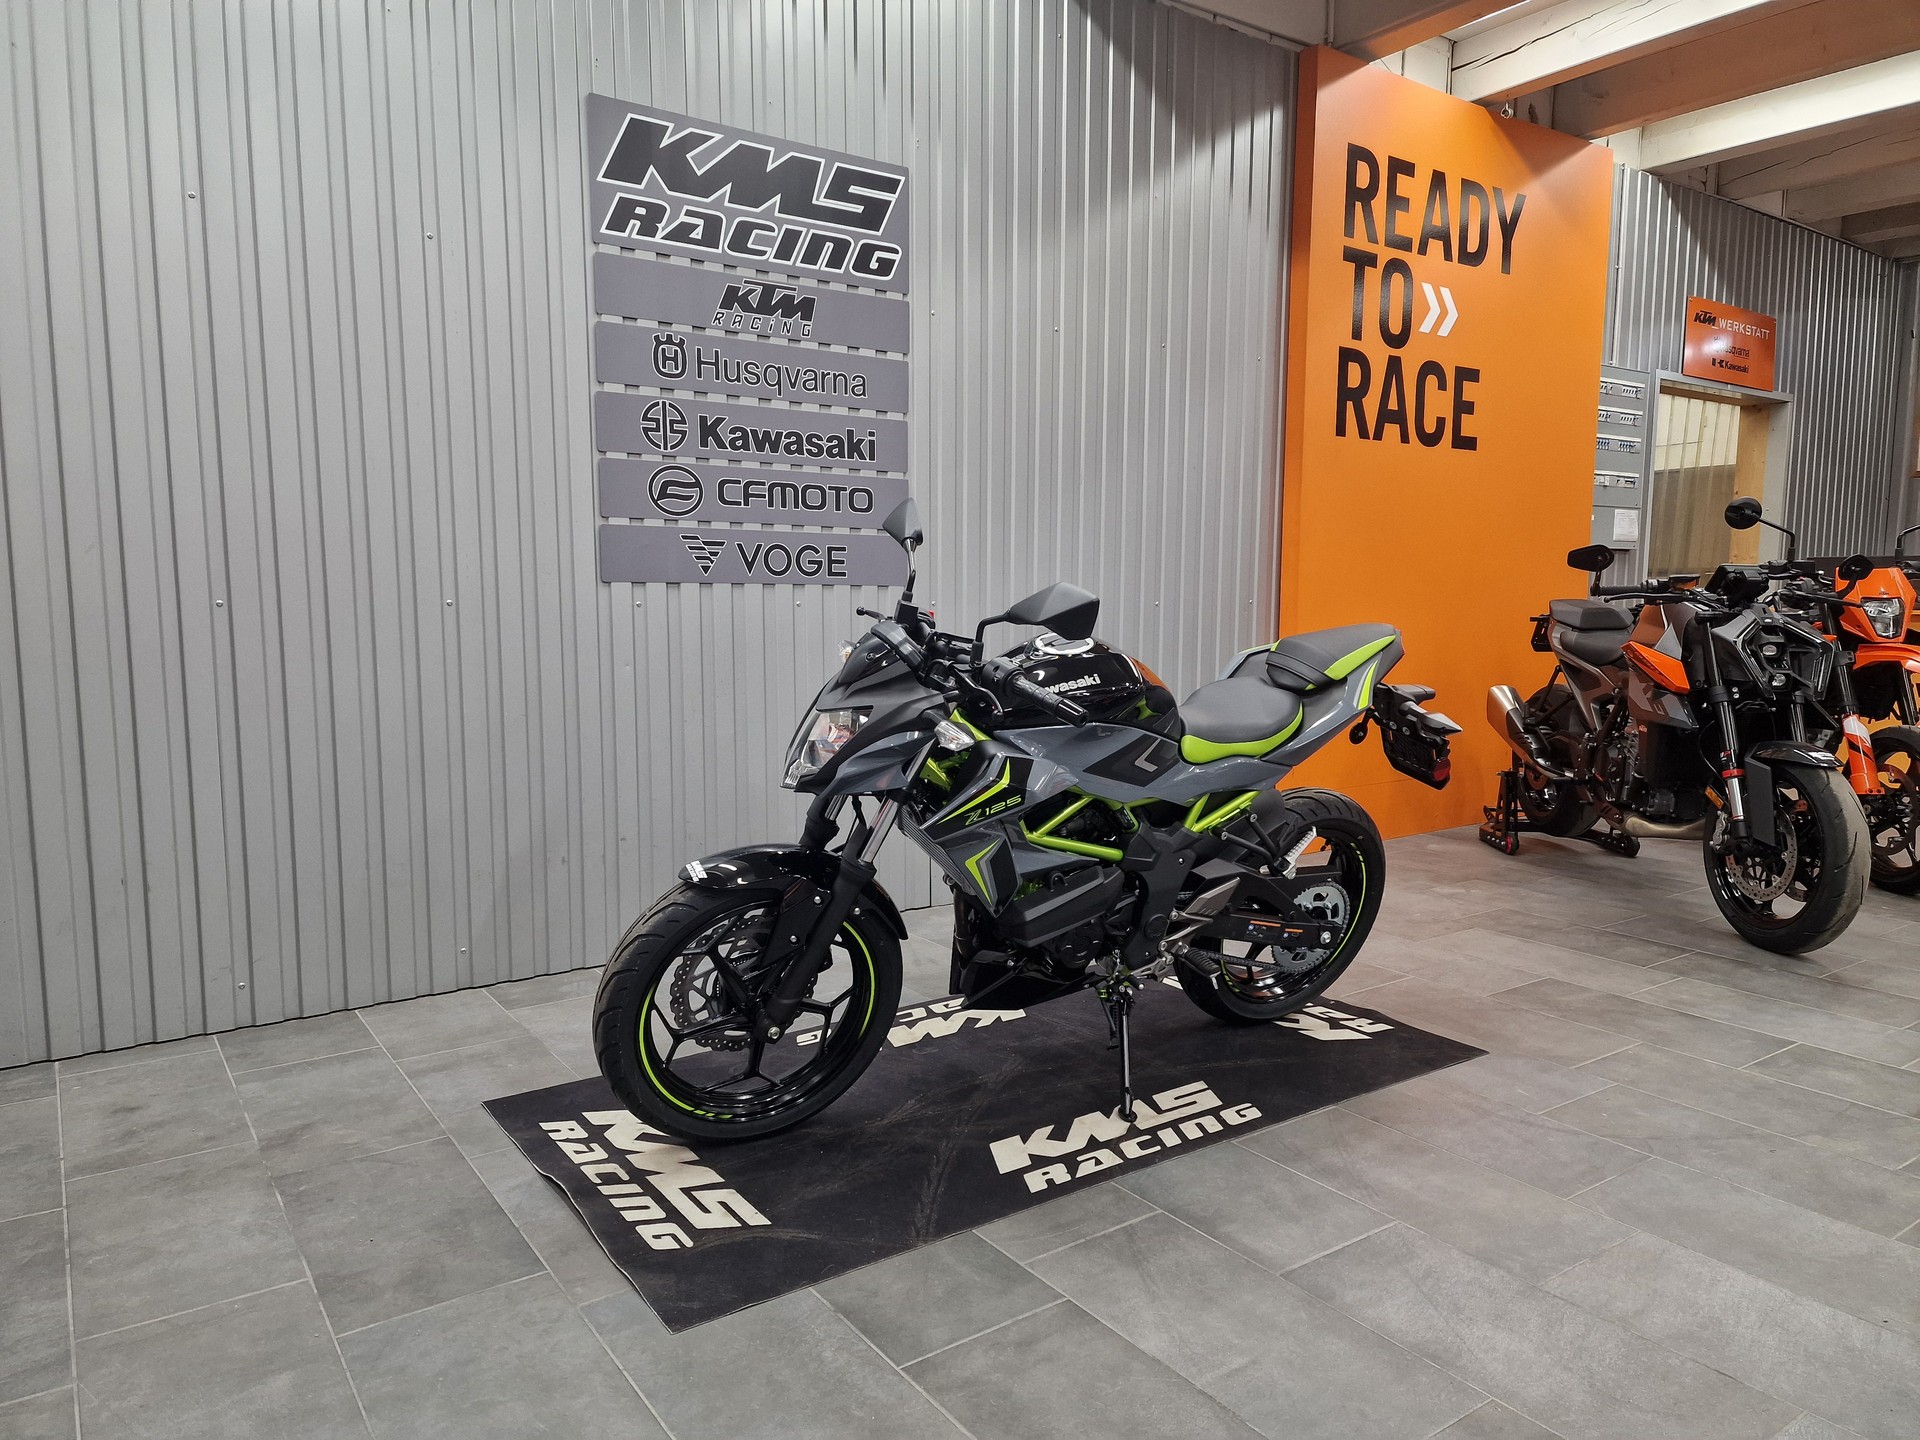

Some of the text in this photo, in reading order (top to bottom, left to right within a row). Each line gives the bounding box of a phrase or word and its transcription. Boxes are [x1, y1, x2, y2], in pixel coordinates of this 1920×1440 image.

[597, 113, 905, 235] KMS
[1343, 142, 1527, 275] READY
[601, 192, 901, 281] RACING
[717, 278, 817, 323] KTM
[1342, 245, 1414, 350] TO
[1694, 310, 1717, 327] KTM
[695, 346, 868, 398] Husqvarna
[1335, 346, 1480, 452] RACE
[698, 414, 876, 462] Kawasaki
[716, 478, 875, 514] CFMOTO
[735, 542, 848, 578] VOGE
[1044, 673, 1101, 693] wasaki
[581, 1109, 772, 1230] KMS
[989, 1080, 1223, 1174] KMS
[1023, 1102, 1263, 1194] RACING
[538, 1120, 694, 1250] RACING
